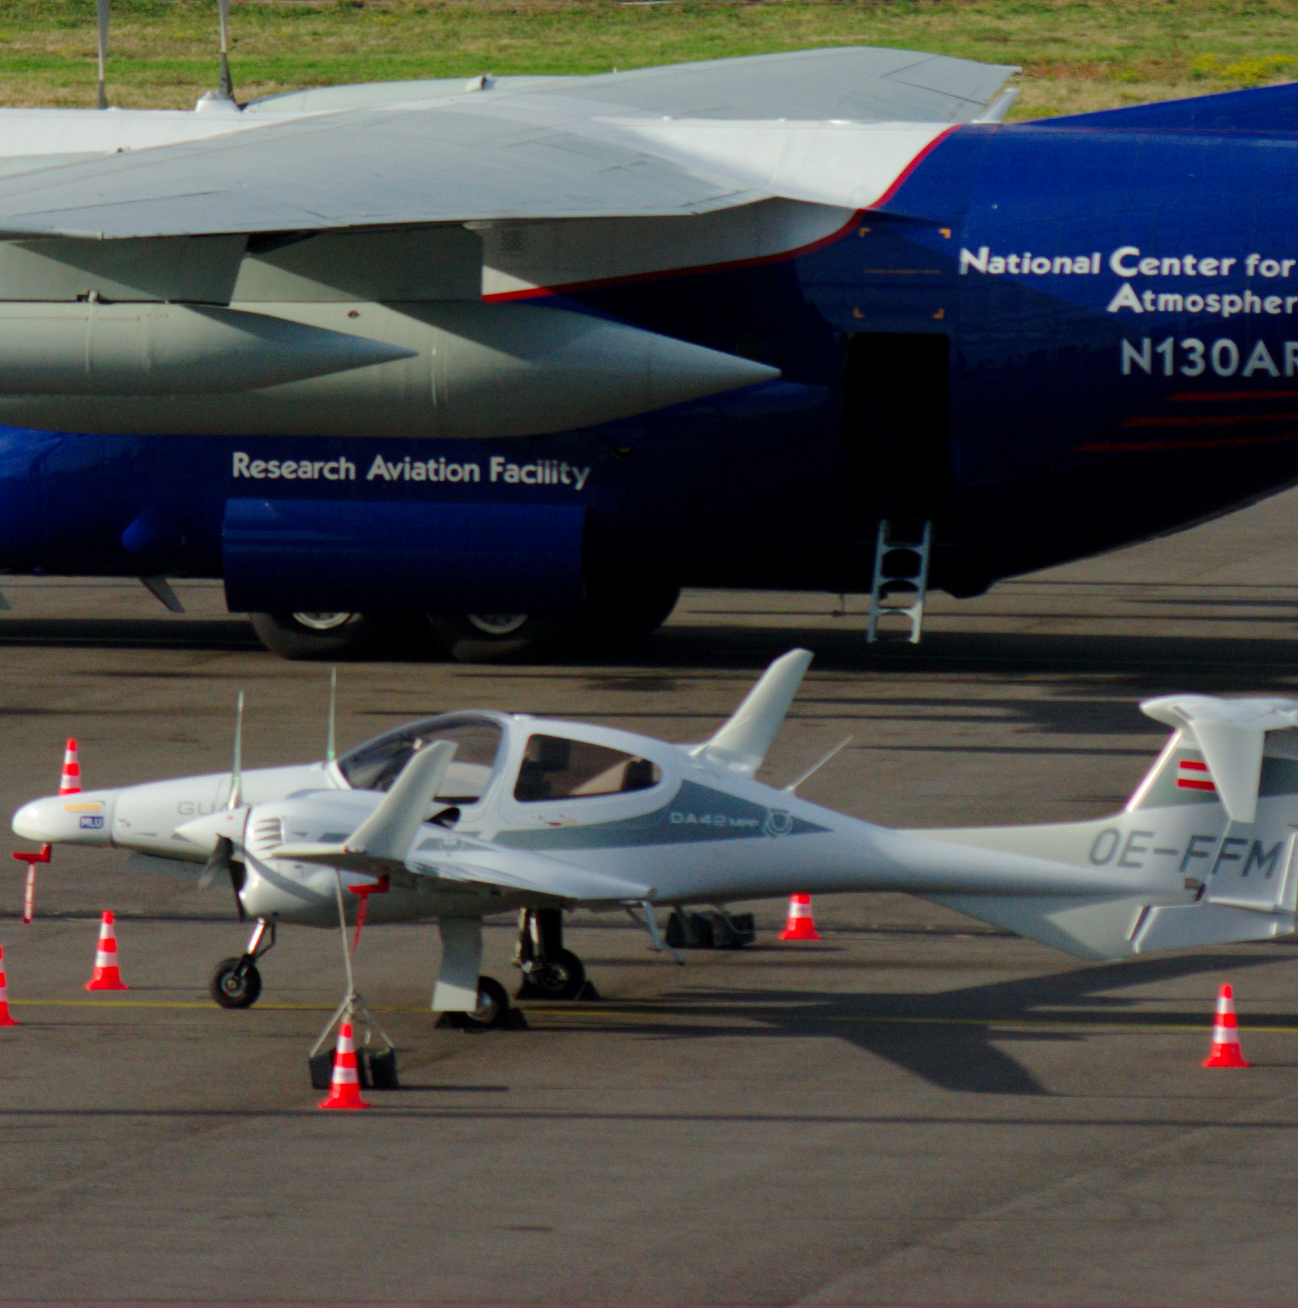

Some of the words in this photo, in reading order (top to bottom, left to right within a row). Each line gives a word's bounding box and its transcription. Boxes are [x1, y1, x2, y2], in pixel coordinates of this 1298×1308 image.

[959, 246, 1101, 275] National
[1109, 245, 1237, 278] Center
[1245, 253, 1297, 278] for
[232, 452, 357, 481] Research
[366, 454, 481, 483] Aviation
[489, 456, 591, 491] Facility
[1089, 827, 1285, 880] OE-FFM
